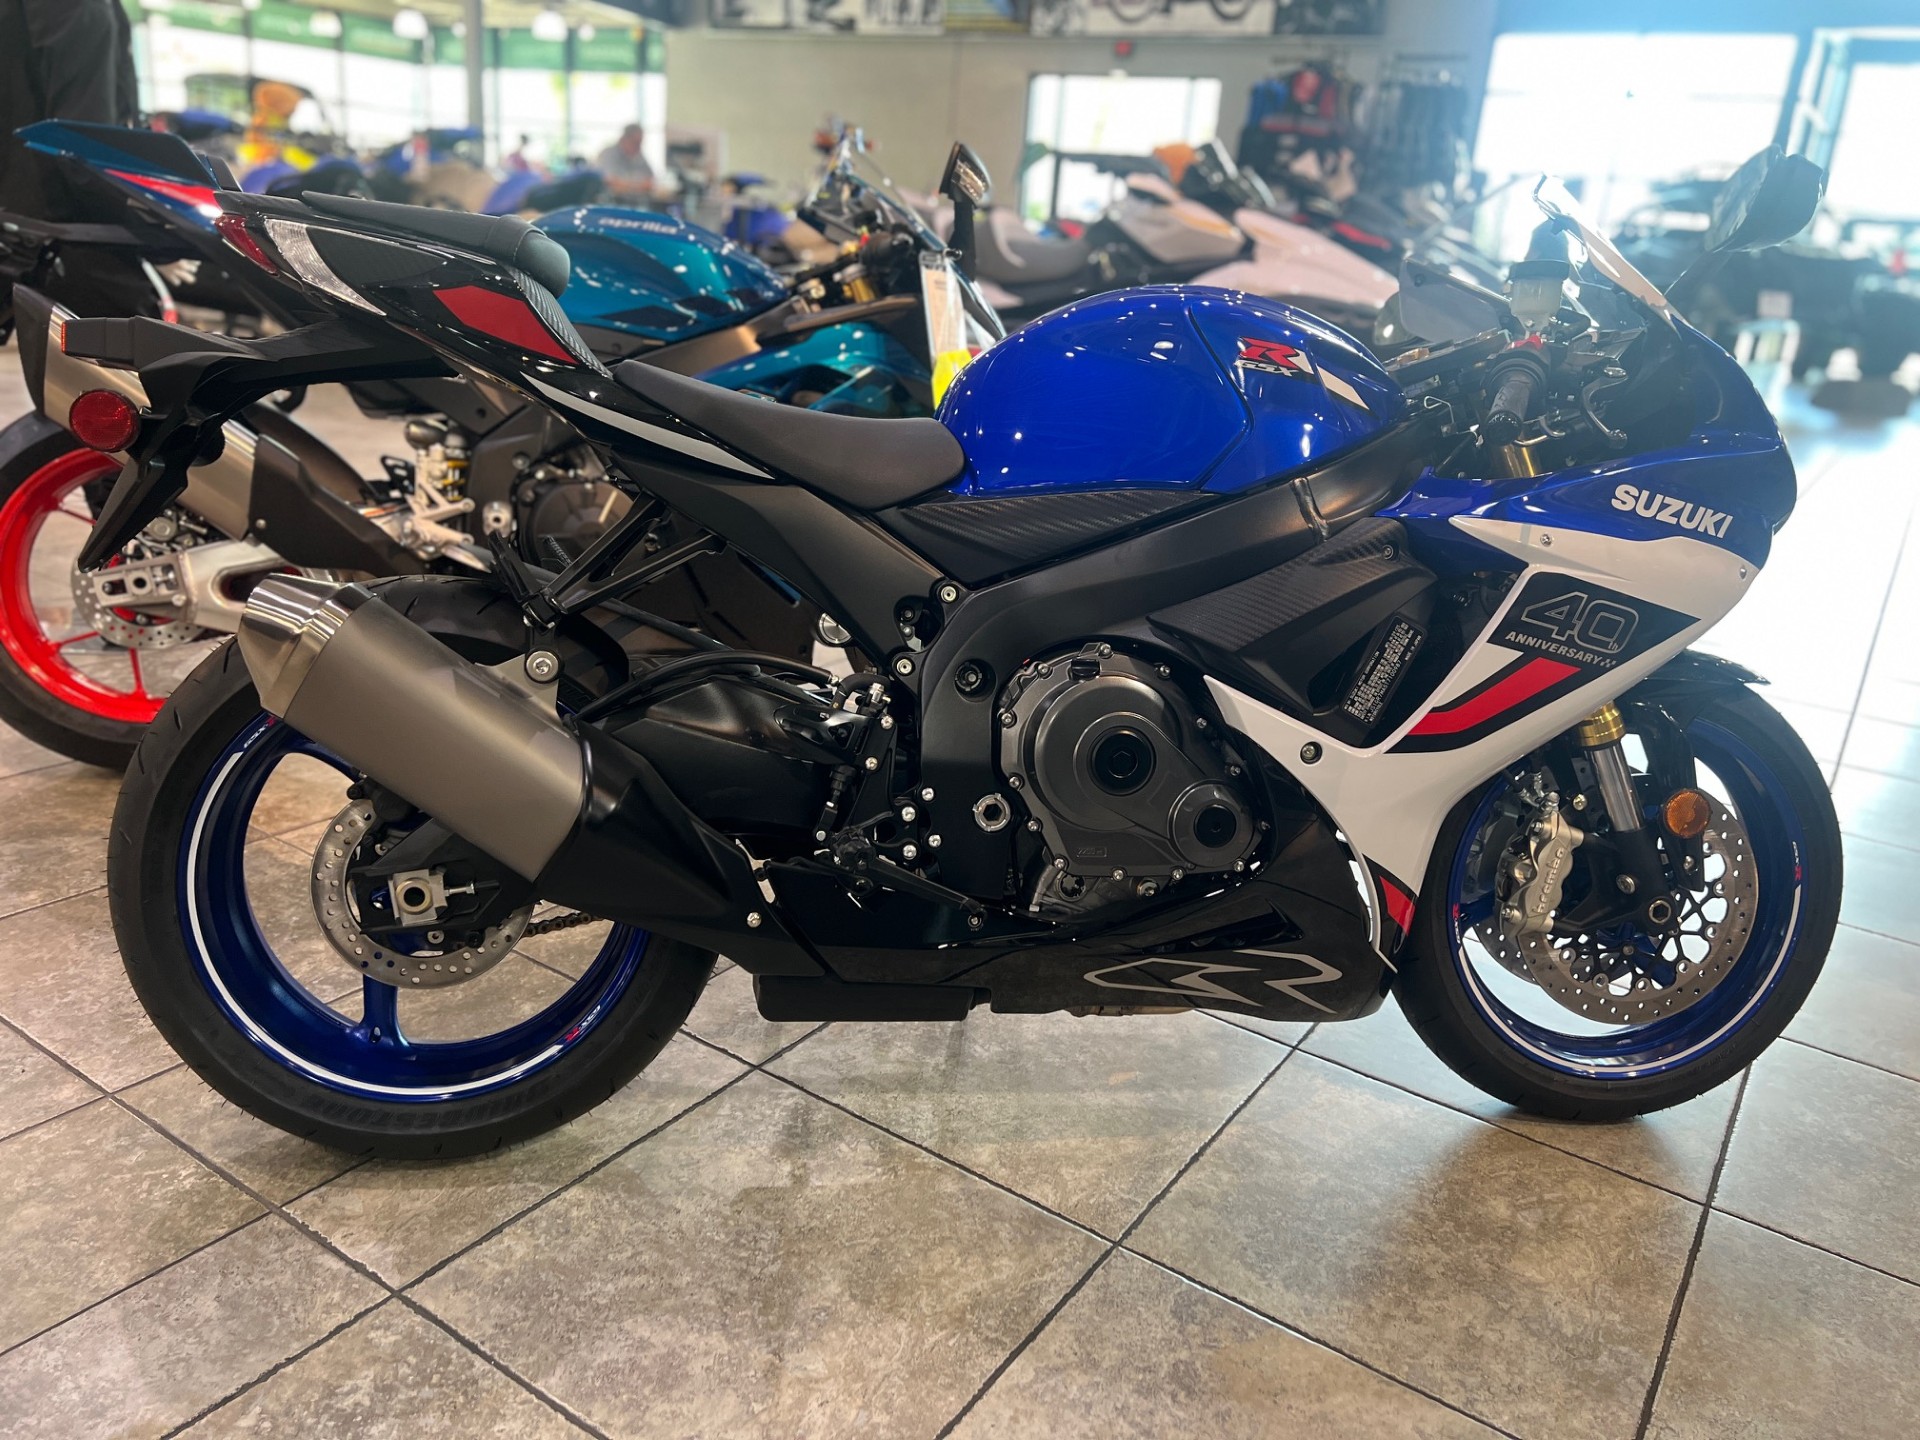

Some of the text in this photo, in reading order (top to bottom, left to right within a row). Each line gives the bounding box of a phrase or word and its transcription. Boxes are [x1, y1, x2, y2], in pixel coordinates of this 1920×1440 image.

[1611, 484, 1733, 538] SUZUKI
[1505, 631, 1602, 666] ANNIVERSARY
[1537, 847, 1564, 914] brembo
